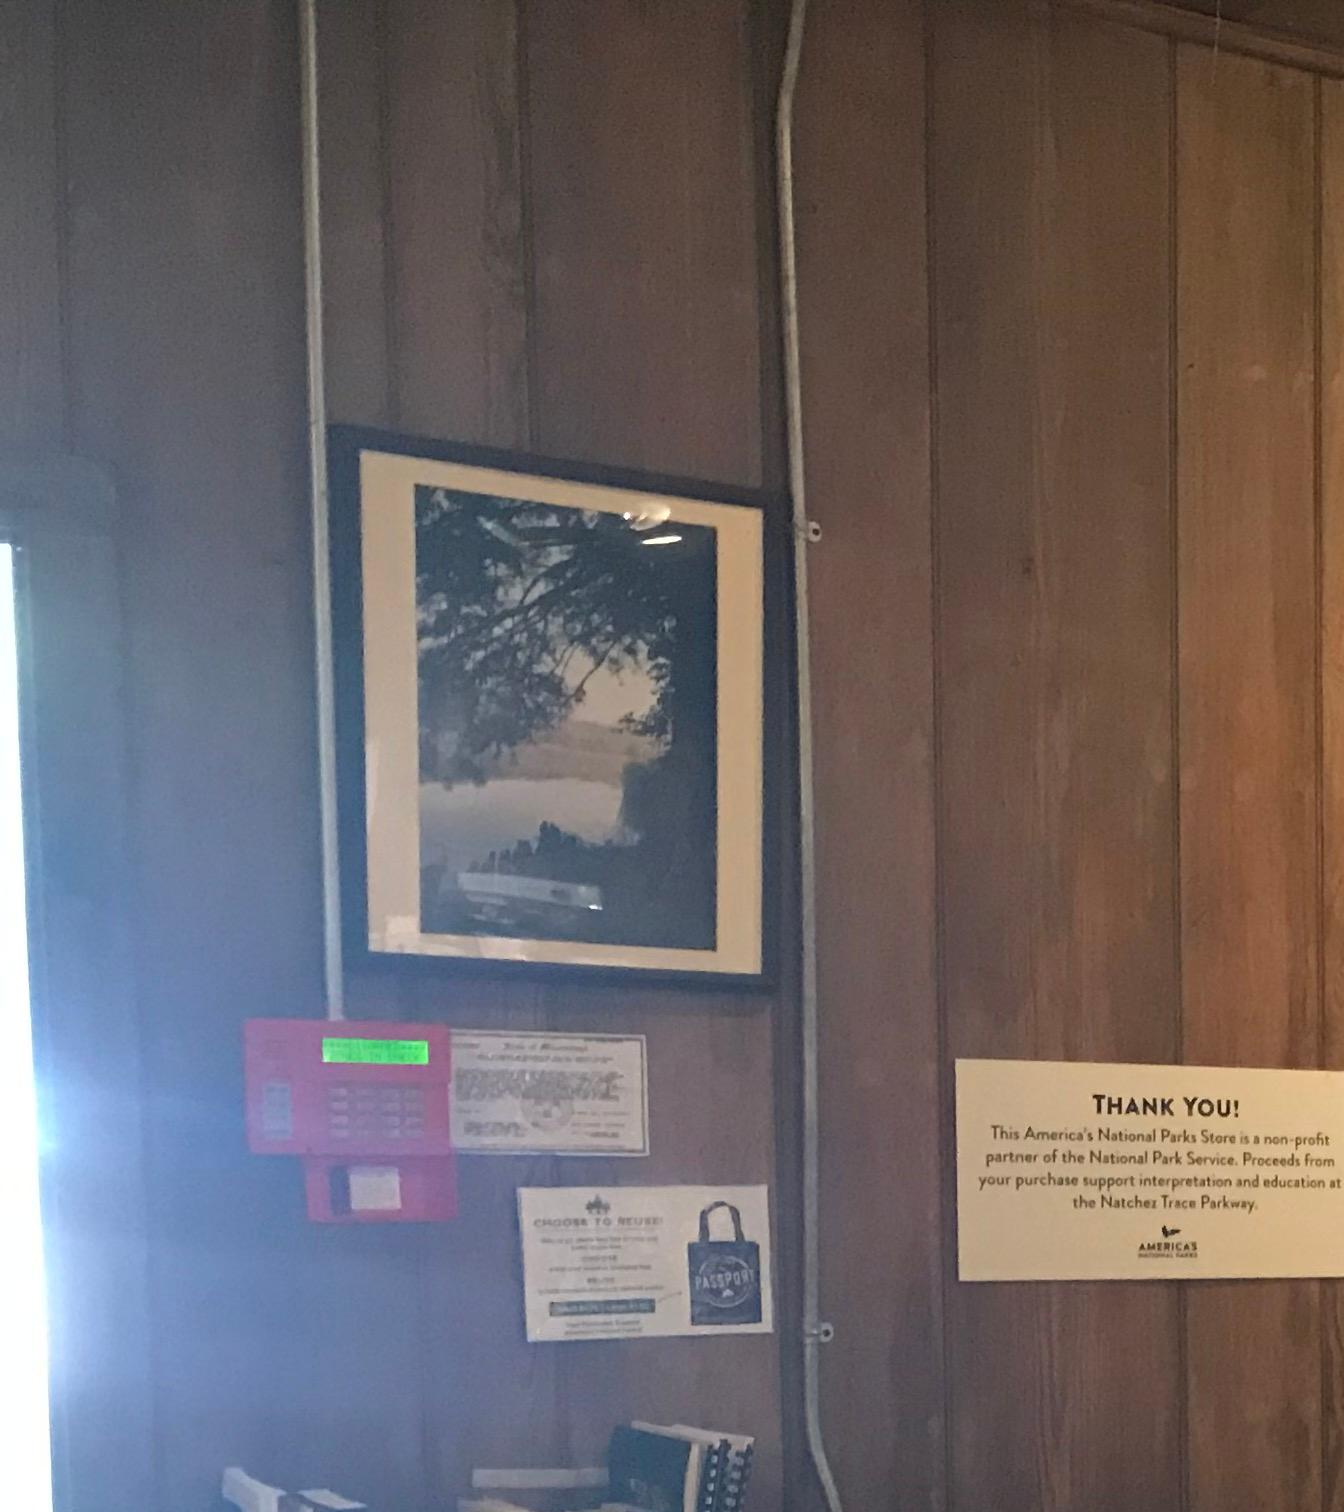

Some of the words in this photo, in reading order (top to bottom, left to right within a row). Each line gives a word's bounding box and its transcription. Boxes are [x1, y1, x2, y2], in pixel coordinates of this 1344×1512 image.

[1092, 1094, 1174, 1116] THANK
[1183, 1096, 1239, 1118] YOU!
[991, 1125, 1020, 1140] This
[1024, 1126, 1093, 1142] America's
[1098, 1127, 1156, 1142] National
[1161, 1129, 1197, 1144] Parks
[1201, 1129, 1236, 1144] Store
[1240, 1131, 1250, 1145] is
[1254, 1135, 1260, 1145] a
[1264, 1132, 1330, 1150] non-profit
[986, 1152, 1038, 1167] partner
[1043, 1149, 1058, 1163] of
[1062, 1150, 1085, 1163] the
[1090, 1151, 1148, 1164] National
[1153, 1151, 1182, 1165] Park
[1187, 1152, 1239, 1166] Service.
[1243, 1152, 1300, 1167] Proceeds
[1304, 1153, 1335, 1167] from
[978, 1175, 1011, 1191] your
[1016, 1172, 1078, 1190] purchase
[1083, 1175, 1135, 1191] support
[1139, 1174, 1232, 1191] interpretation
[1236, 1174, 1259, 1188] and
[1263, 1174, 1326, 1189] education
[1329, 1177, 1341, 1189] at
[1073, 1195, 1096, 1209] the
[1101, 1195, 1157, 1209] Natchez
[1161, 1195, 1196, 1209] Trace
[1201, 1195, 1258, 1214] Parkway.
[695, 1269, 754, 1290] PASSPORT
